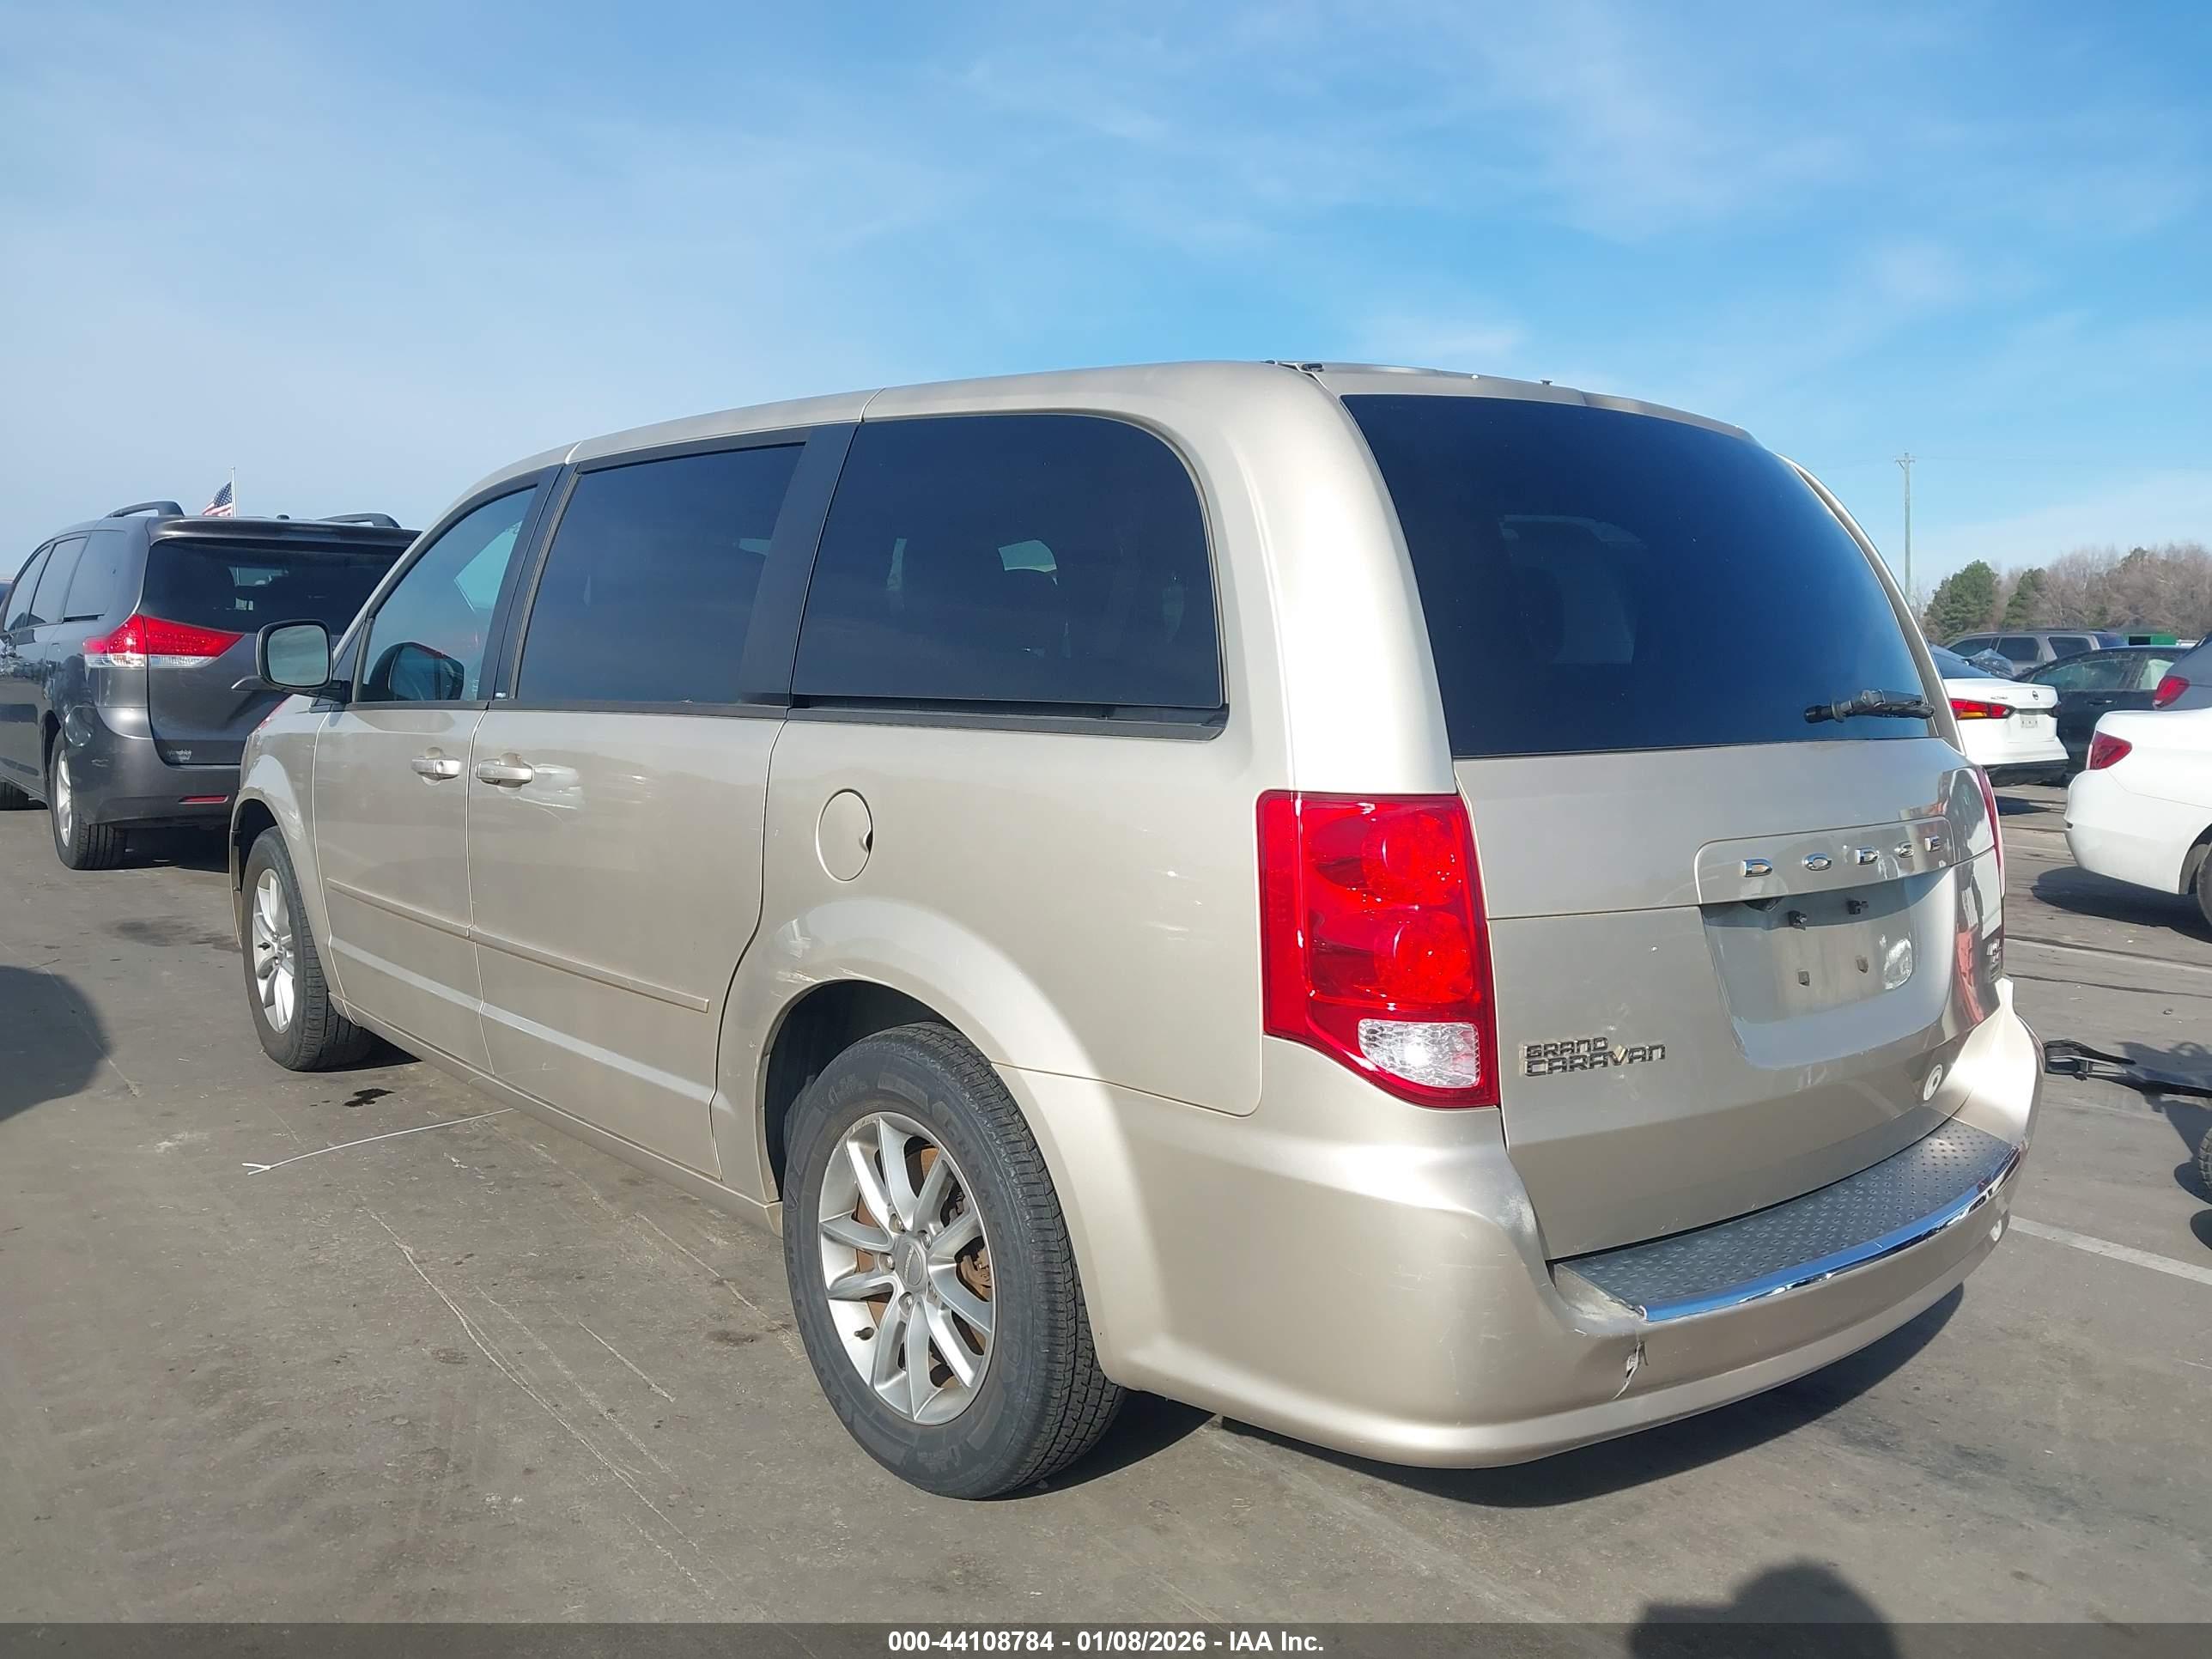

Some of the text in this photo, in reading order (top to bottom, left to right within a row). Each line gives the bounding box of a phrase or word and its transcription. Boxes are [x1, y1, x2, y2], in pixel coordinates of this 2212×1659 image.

[1741, 835, 1942, 878] DODGE
[1523, 1036, 1608, 1059] GRAND
[1523, 1044, 1666, 1077] CARAVAN
